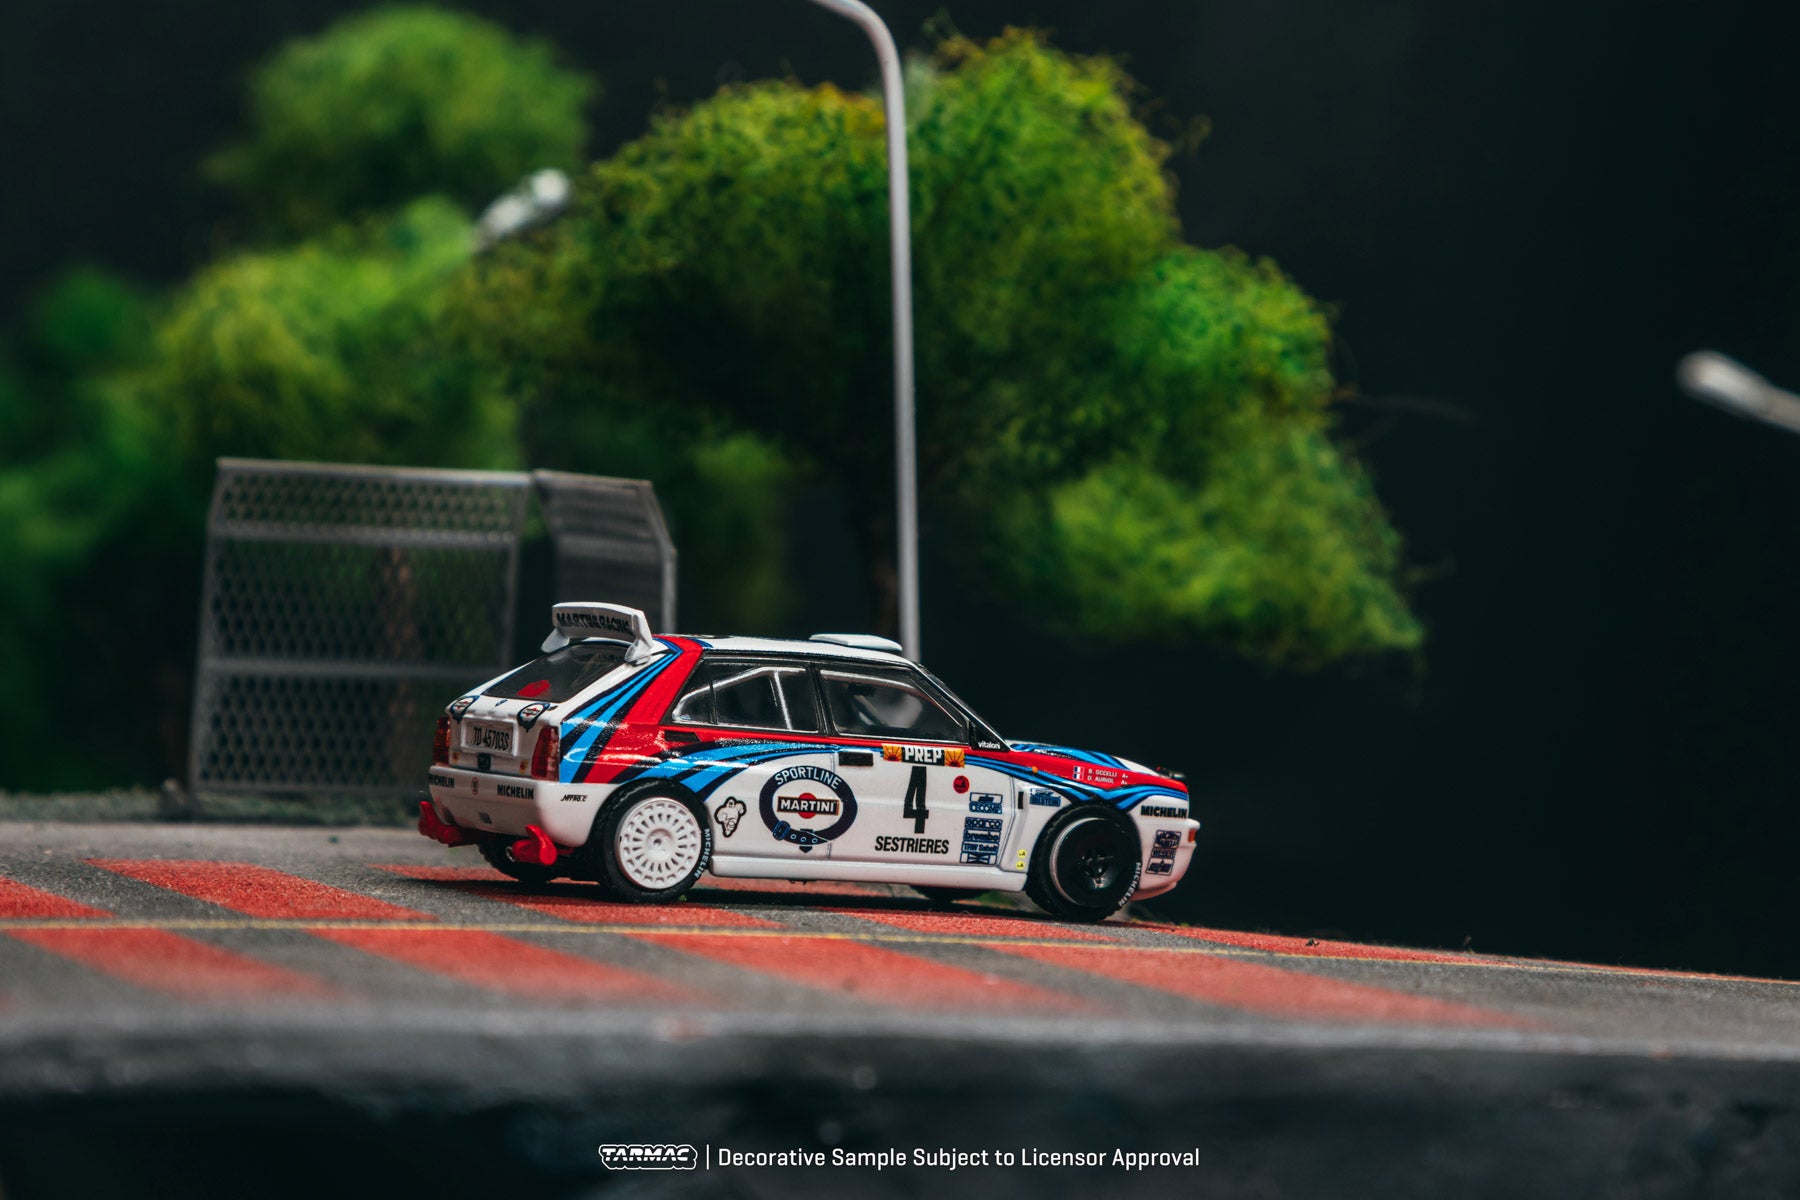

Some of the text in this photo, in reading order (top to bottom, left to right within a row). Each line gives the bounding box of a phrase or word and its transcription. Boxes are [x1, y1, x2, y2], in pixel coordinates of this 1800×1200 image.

[556, 612, 600, 629] MARTINI
[904, 745, 943, 763] PREP
[775, 766, 842, 790] SPORTLINE
[497, 784, 534, 799] MICHELIN
[903, 765, 929, 834] 4
[780, 799, 834, 813] MARTINI
[1141, 806, 1187, 818] MICHELIN
[694, 828, 711, 878] MICHELIN
[875, 836, 949, 854] SESTRIERES
[1118, 862, 1141, 907] MICHELIN
